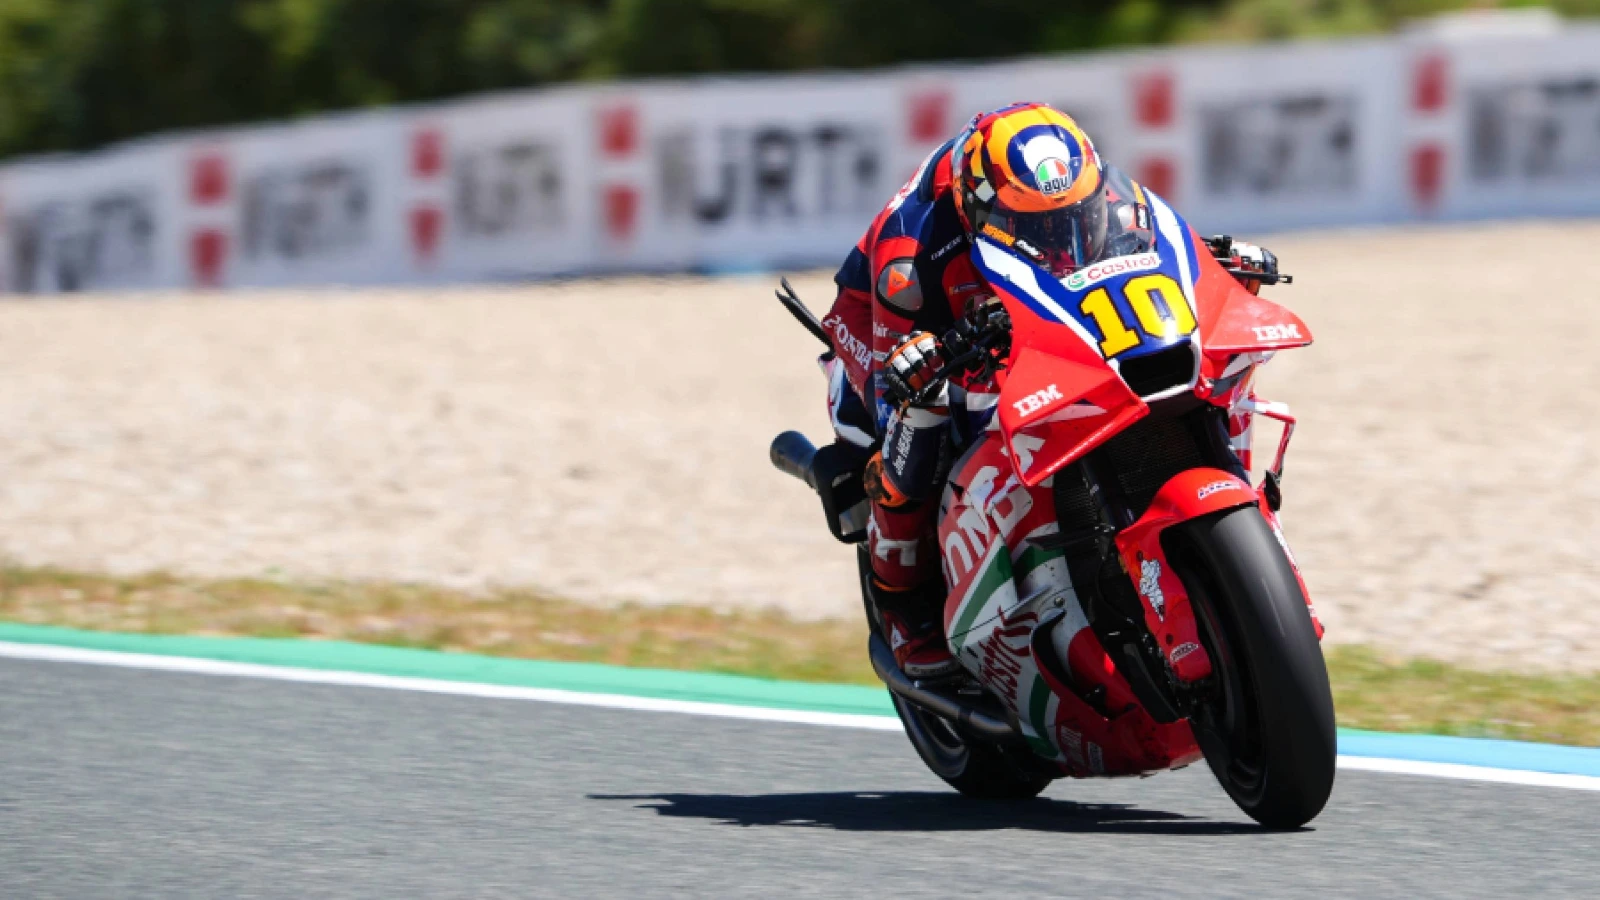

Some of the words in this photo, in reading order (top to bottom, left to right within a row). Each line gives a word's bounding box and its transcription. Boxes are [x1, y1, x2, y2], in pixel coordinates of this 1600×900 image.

[1087, 255, 1157, 280] Castrol
[1079, 273, 1199, 360] 10
[1251, 324, 1302, 341] IBM
[1012, 384, 1064, 417] IBM
